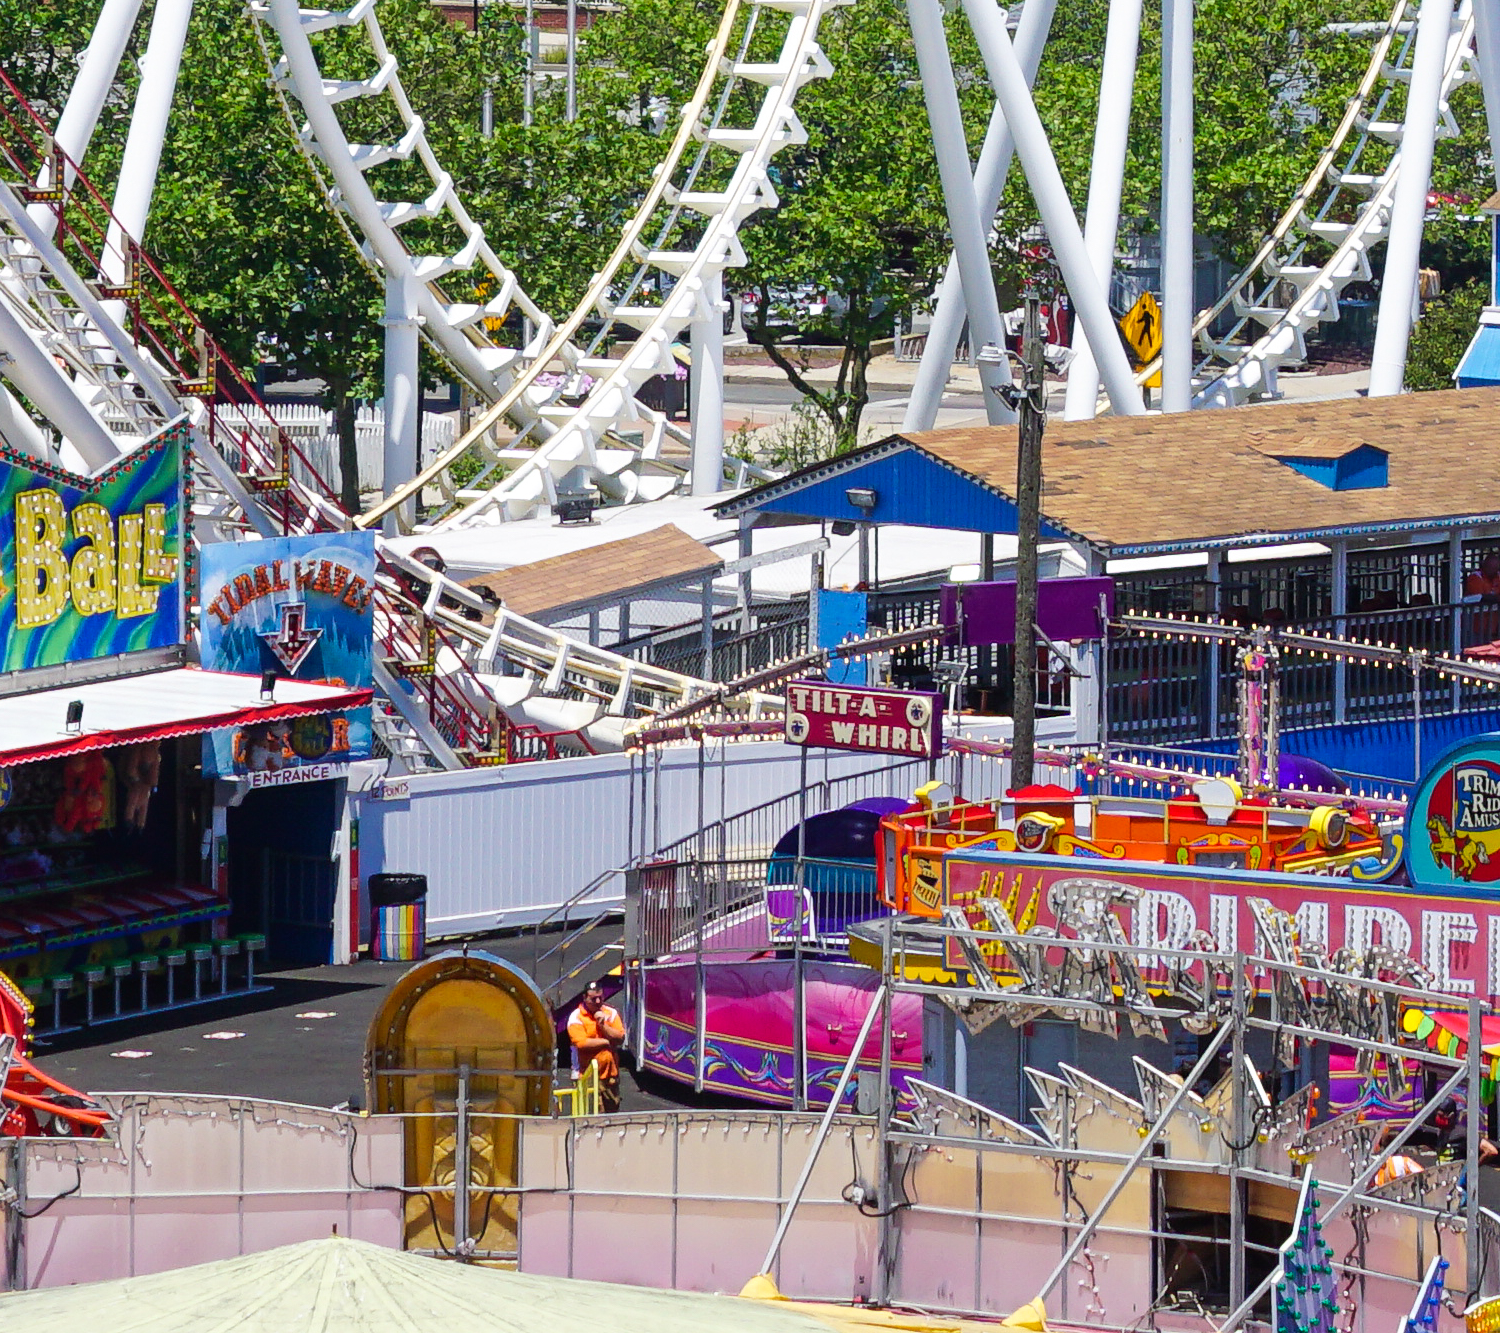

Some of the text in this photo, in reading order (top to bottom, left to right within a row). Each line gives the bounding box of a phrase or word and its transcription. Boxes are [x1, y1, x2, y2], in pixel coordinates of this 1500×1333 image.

[207, 559, 290, 626] TIDAL
[831, 720, 923, 753] WHIRL
[252, 766, 330, 787] ENTRANCE
